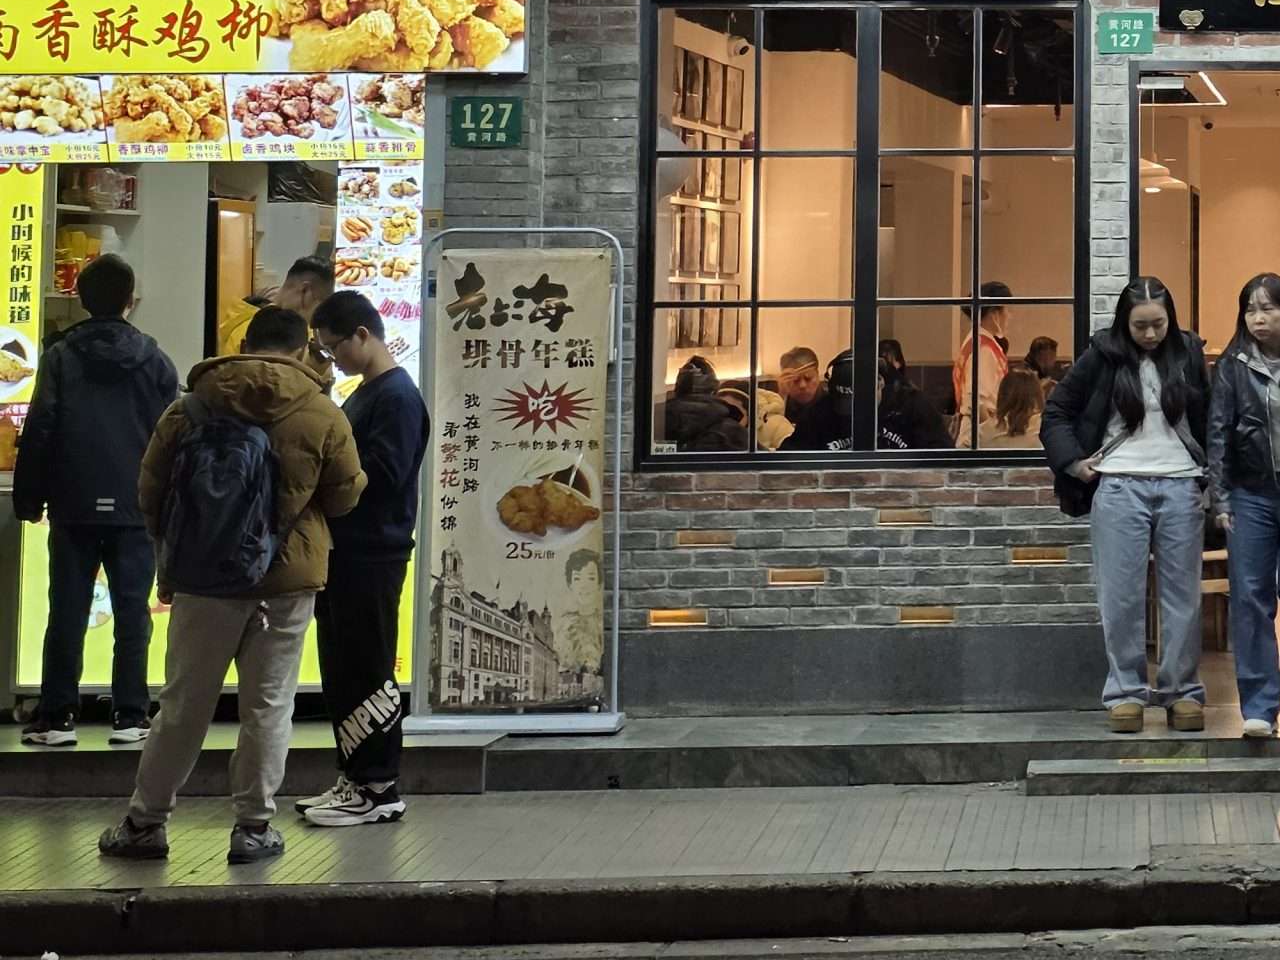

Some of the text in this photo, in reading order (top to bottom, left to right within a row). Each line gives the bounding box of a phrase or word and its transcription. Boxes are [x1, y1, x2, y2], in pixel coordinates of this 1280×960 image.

[1109, 19, 1144, 30] 黄河路
[1110, 33, 1141, 48] 127
[461, 103, 513, 129] 127
[467, 132, 507, 143] 黄河路
[10, 203, 34, 325] 小时候的味道
[445, 262, 575, 332] 老上海
[462, 337, 596, 369] 排骨年糕
[528, 393, 559, 421] 吃
[462, 393, 481, 494] 我在黄河路
